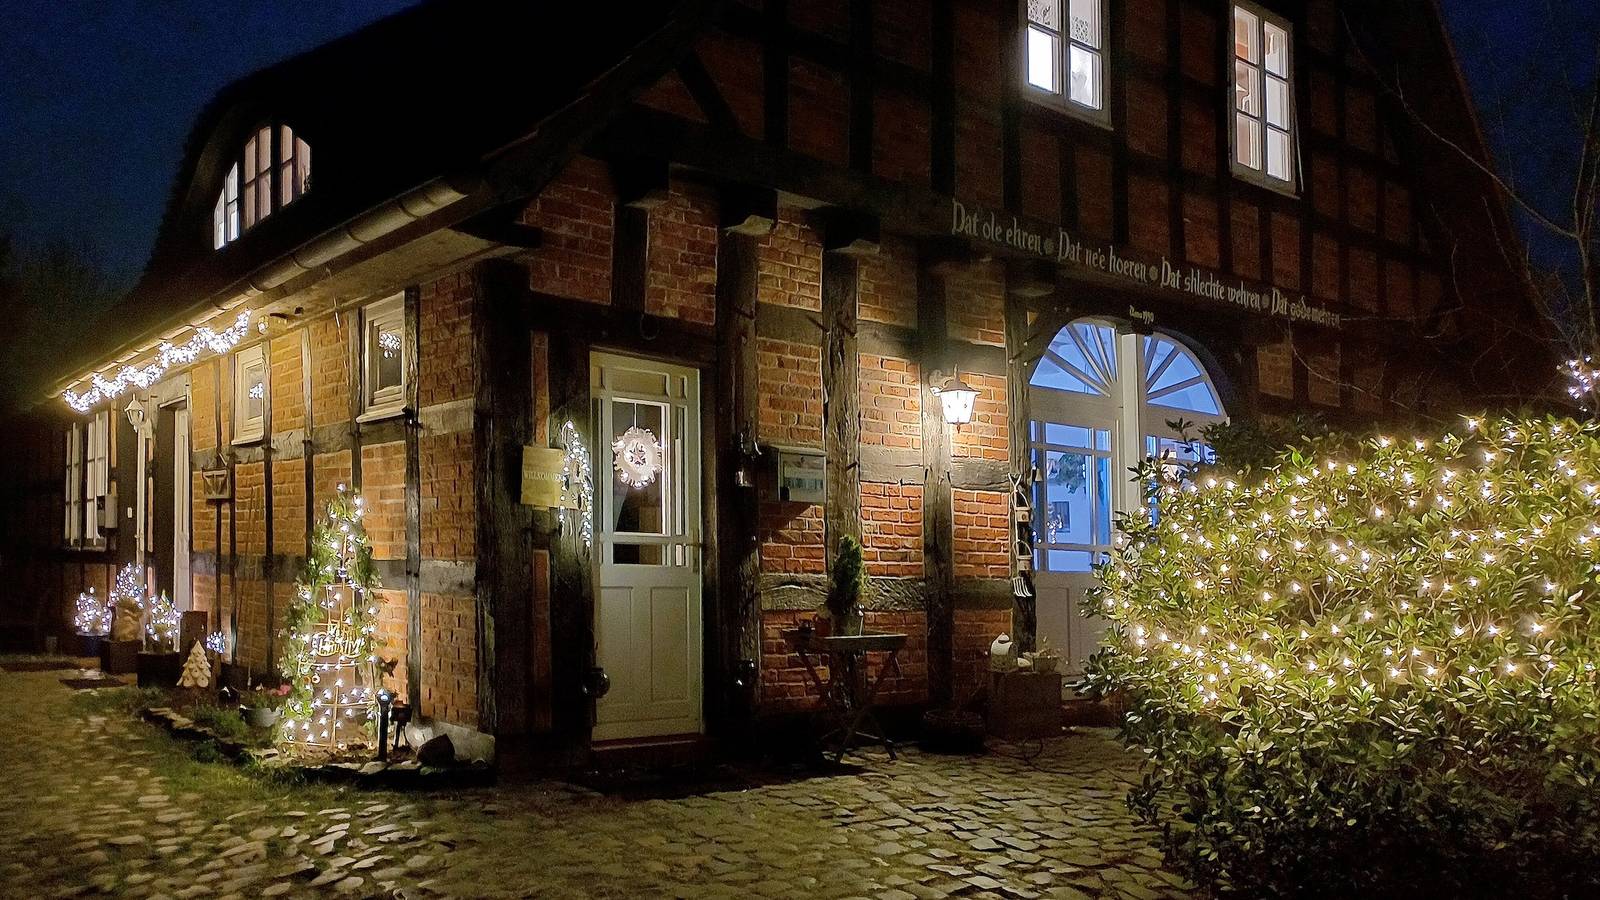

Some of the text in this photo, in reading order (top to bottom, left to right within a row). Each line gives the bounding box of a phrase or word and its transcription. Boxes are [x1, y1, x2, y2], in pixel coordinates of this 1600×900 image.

[952, 198, 978, 236] Dat
[982, 212, 1002, 242] ole
[1006, 217, 1043, 256] ehren
[1058, 227, 1082, 262] Dat
[1109, 245, 1148, 283] hoeren
[1160, 256, 1182, 289] Dat
[1227, 280, 1261, 312] wehren
